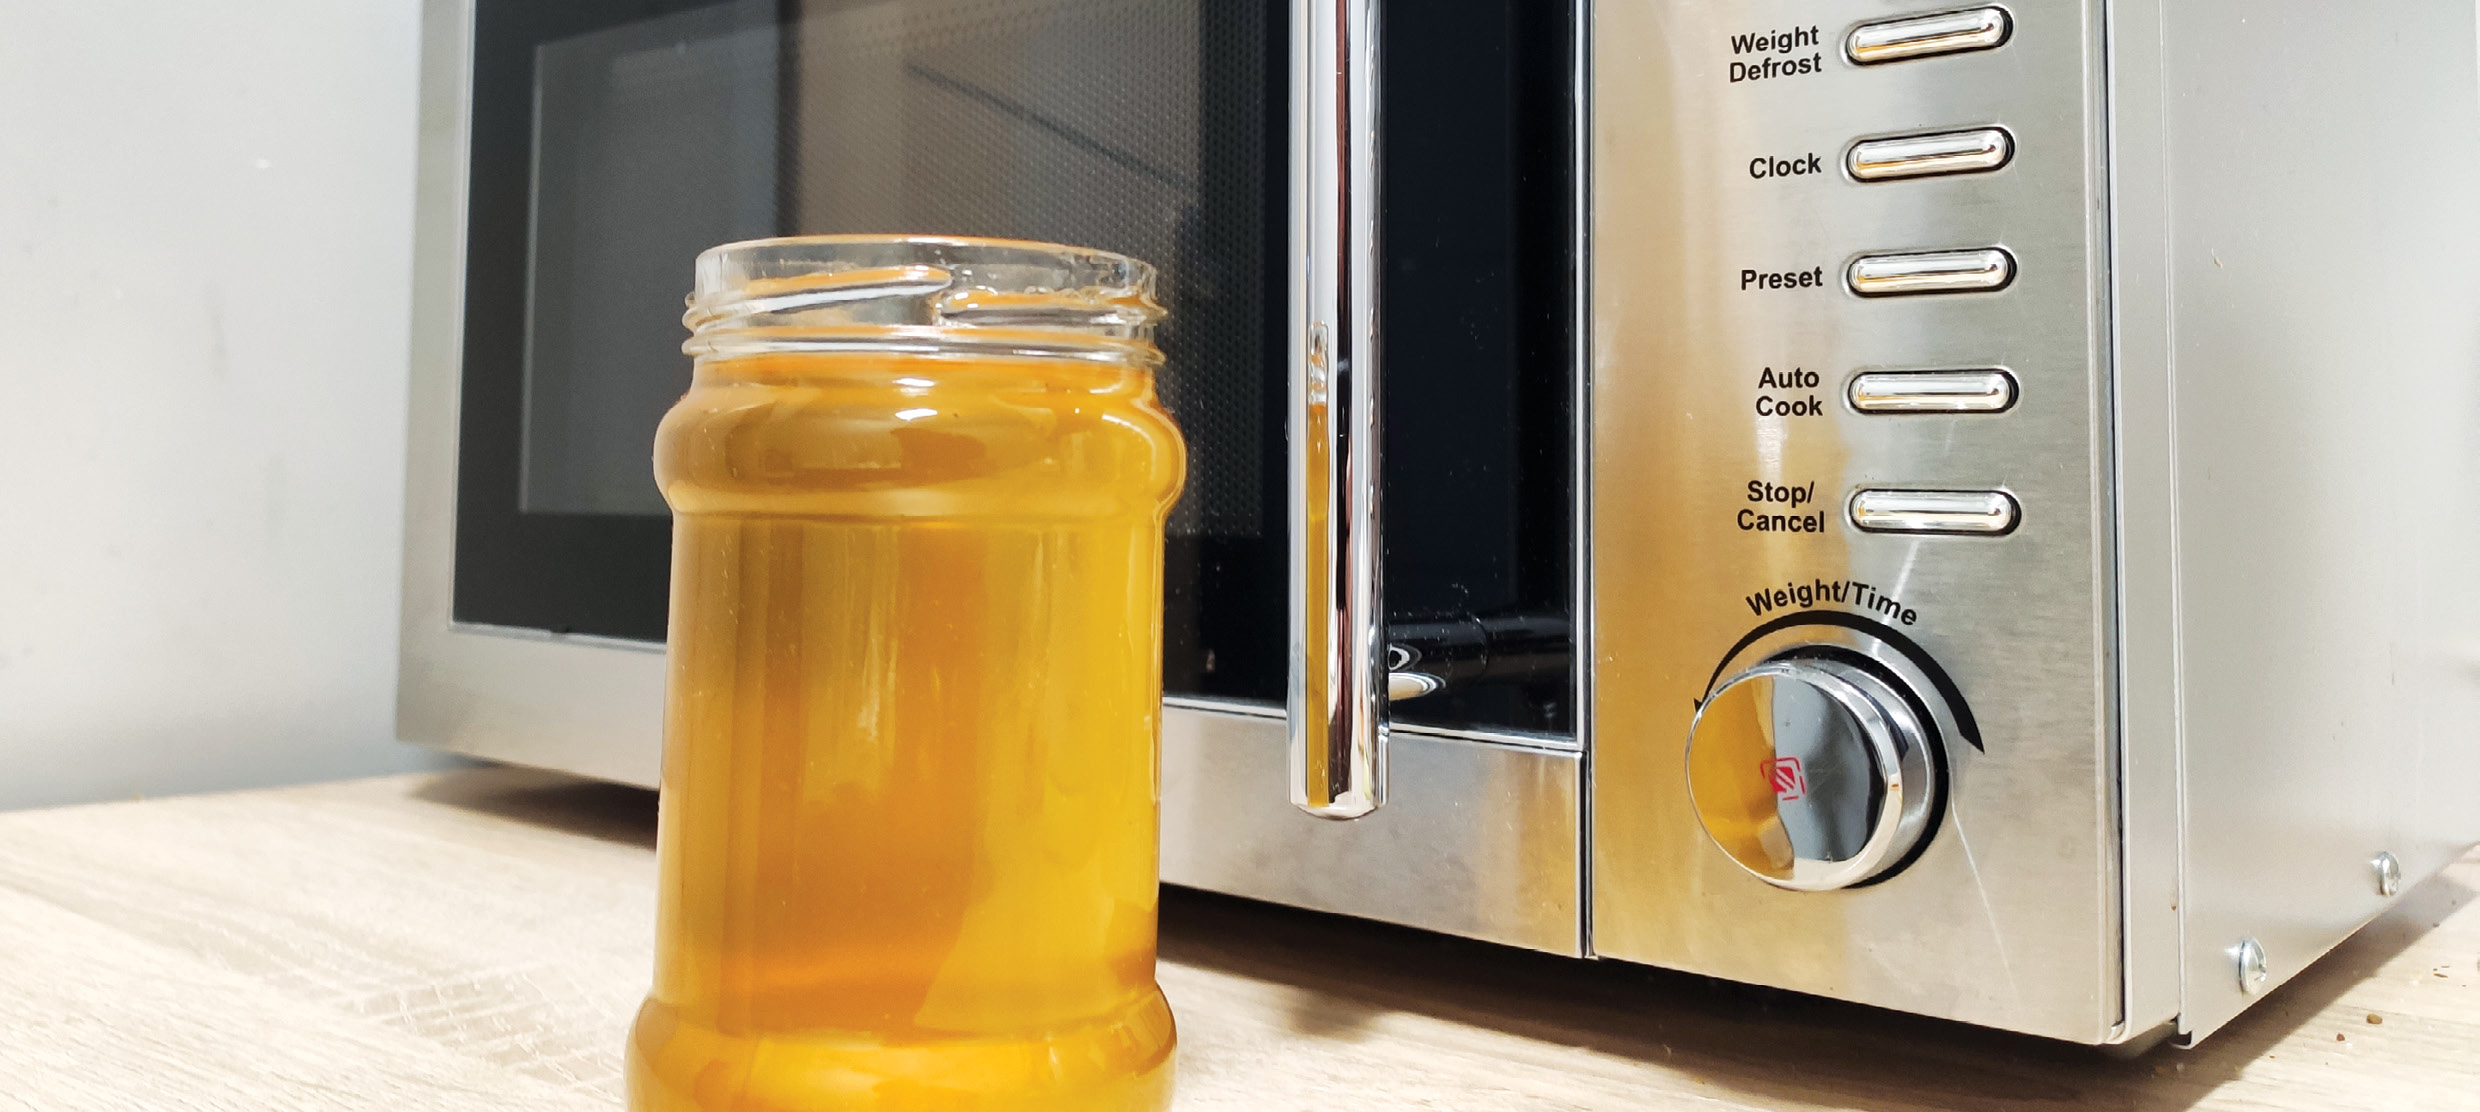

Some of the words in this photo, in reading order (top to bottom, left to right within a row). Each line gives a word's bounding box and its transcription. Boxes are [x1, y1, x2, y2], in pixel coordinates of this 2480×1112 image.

[1730, 25, 1819, 55] Weight
[1729, 52, 1822, 83] Defrost
[1749, 152, 1822, 179] Clock
[1740, 266, 1823, 291] Preset
[1757, 367, 1820, 389] Auto
[1755, 394, 1823, 417] Cook
[1746, 480, 1815, 509] Stop/
[1736, 508, 1825, 533] Cancel
[1745, 578, 1918, 626] Weight/Time
